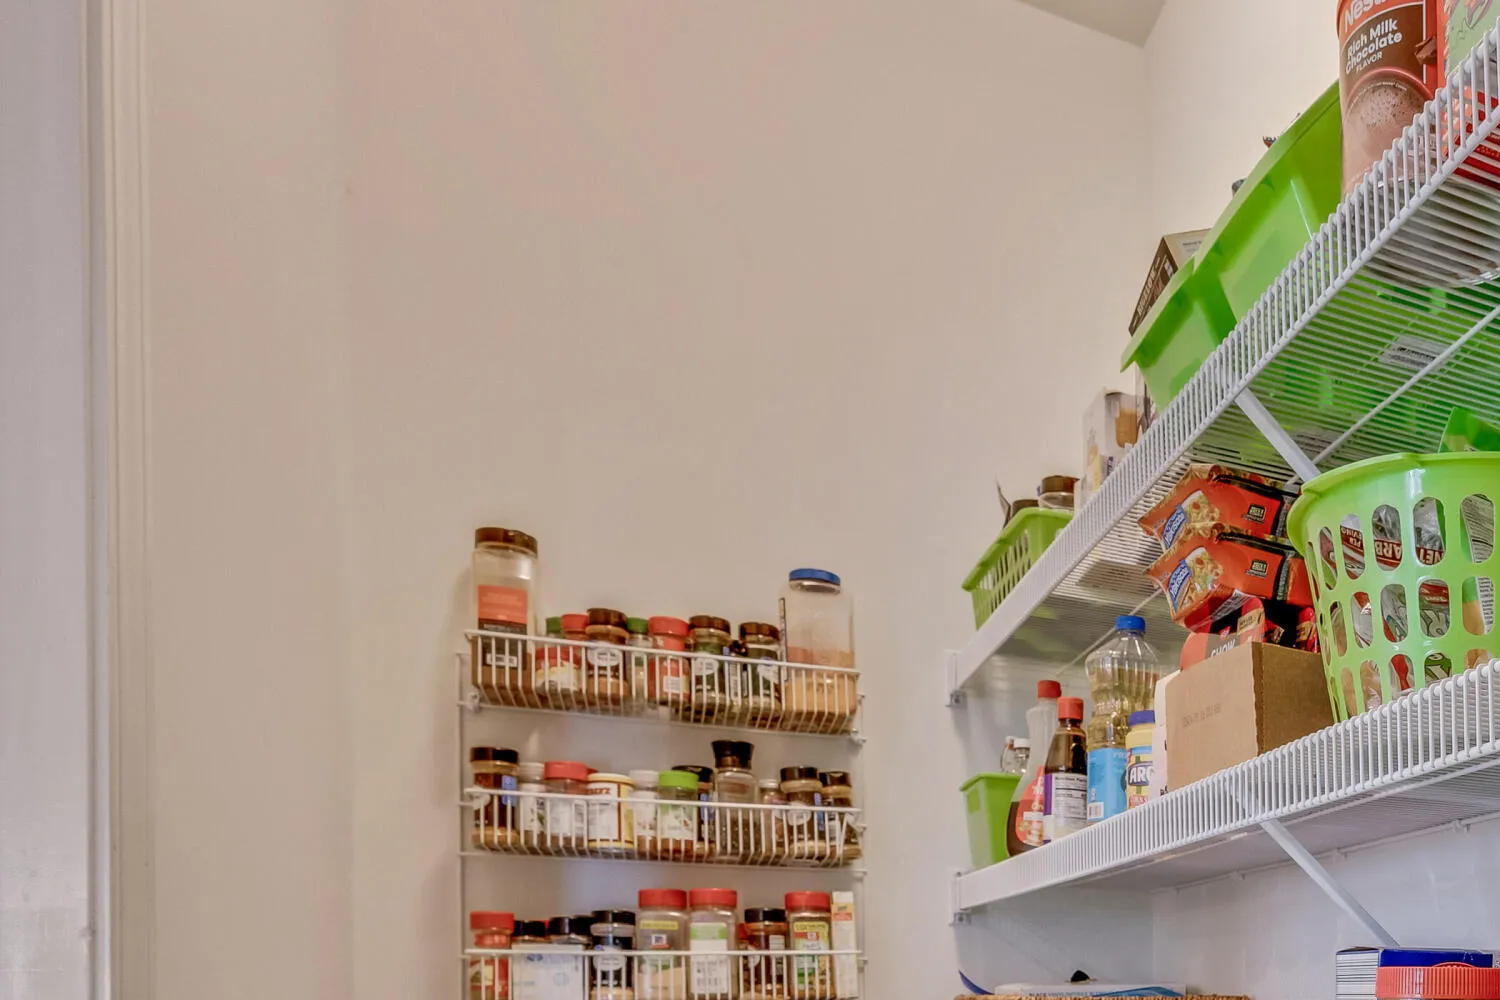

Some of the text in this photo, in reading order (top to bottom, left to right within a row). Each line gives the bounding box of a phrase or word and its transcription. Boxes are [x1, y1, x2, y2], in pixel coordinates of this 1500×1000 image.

[1345, 32, 1402, 75] Chocolate
[1347, 18, 1398, 59] Rich Milk
[1356, 52, 1383, 74] FLAVOR
